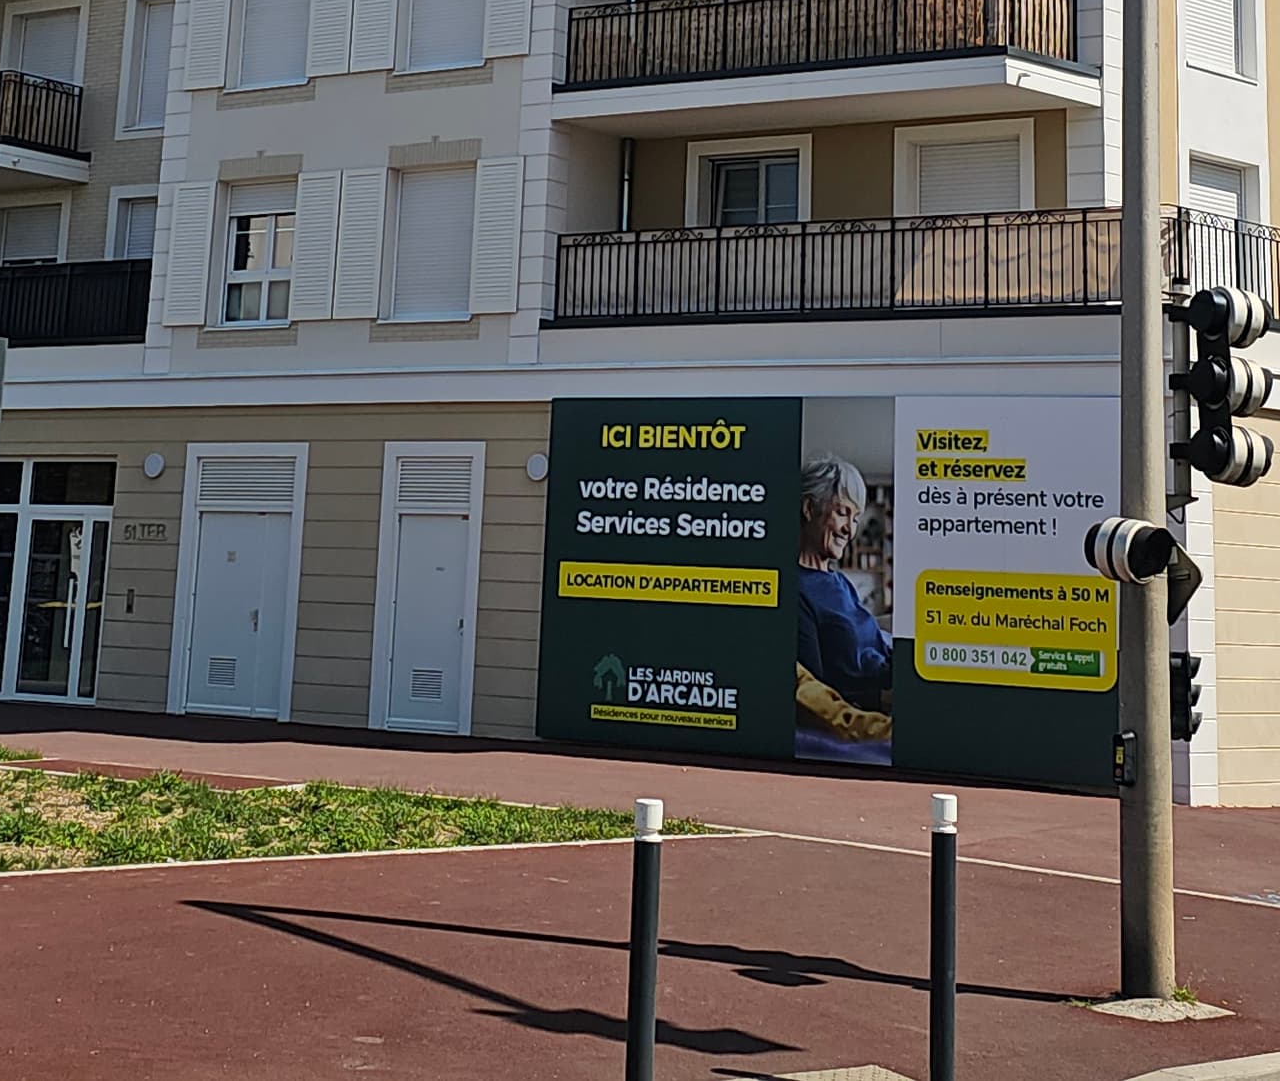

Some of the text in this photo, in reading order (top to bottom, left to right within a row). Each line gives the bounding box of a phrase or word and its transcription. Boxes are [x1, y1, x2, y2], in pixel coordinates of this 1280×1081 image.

[602, 419, 746, 449] ICI BIENTÔT
[918, 431, 988, 452] Visitez,
[918, 459, 1026, 478] et réservez
[579, 476, 765, 502] votre Résidence
[918, 486, 1104, 510] dès à présent votre
[124, 523, 166, 540] 51 TER
[576, 510, 766, 539] Services Seniors
[918, 516, 1046, 536] appartement
[566, 573, 772, 595] LOCATION D'APPARTEMENTS
[926, 581, 1109, 603] Renseignements à 50 M
[926, 610, 1107, 633] 51 av. du Maréchal Foch
[930, 646, 1027, 666] 0 800 351 042
[1038, 650, 1066, 662] Service
[1074, 652, 1094, 664] appel
[628, 667, 714, 686] LES JARDINS
[1038, 662, 1067, 672] gratuits
[627, 682, 738, 710] D'ARCADIE
[593, 707, 734, 728] Résidences pour nouveaux seniors
